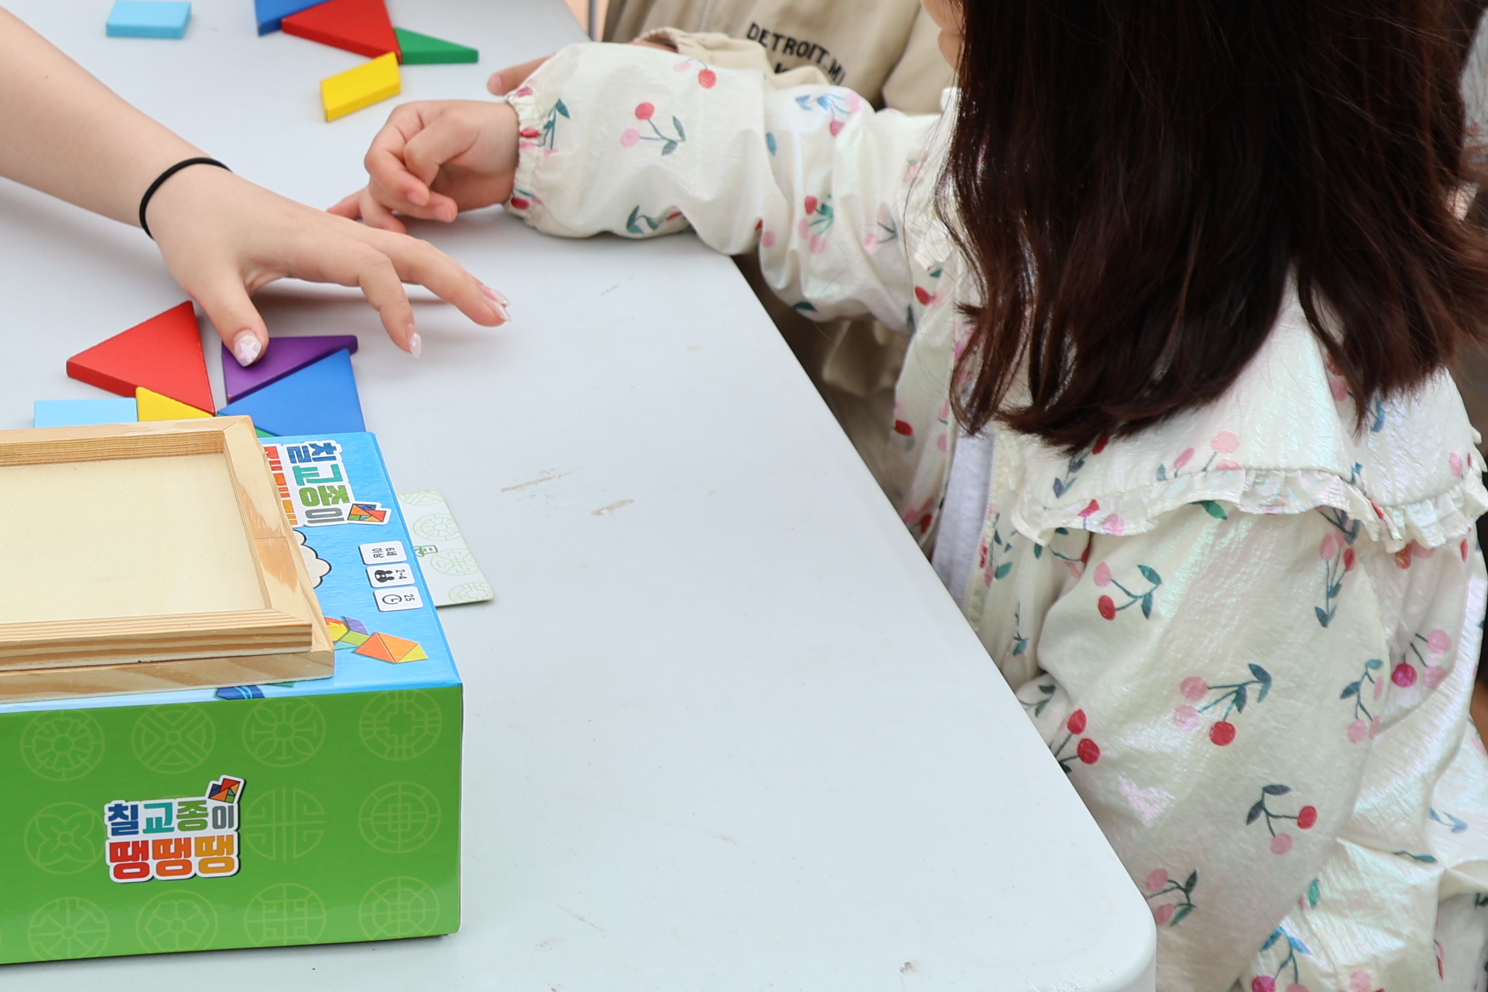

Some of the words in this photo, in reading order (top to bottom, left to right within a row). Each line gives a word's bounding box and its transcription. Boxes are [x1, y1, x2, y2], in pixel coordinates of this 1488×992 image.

[286, 442, 350, 524] 칠교종이
[372, 548, 385, 558] 이상
[385, 547, 398, 556] 6세
[396, 569, 408, 580] 2-4
[404, 593, 415, 602] 25
[108, 800, 234, 836] 칠교종이
[109, 835, 235, 880] 땡땡땡
